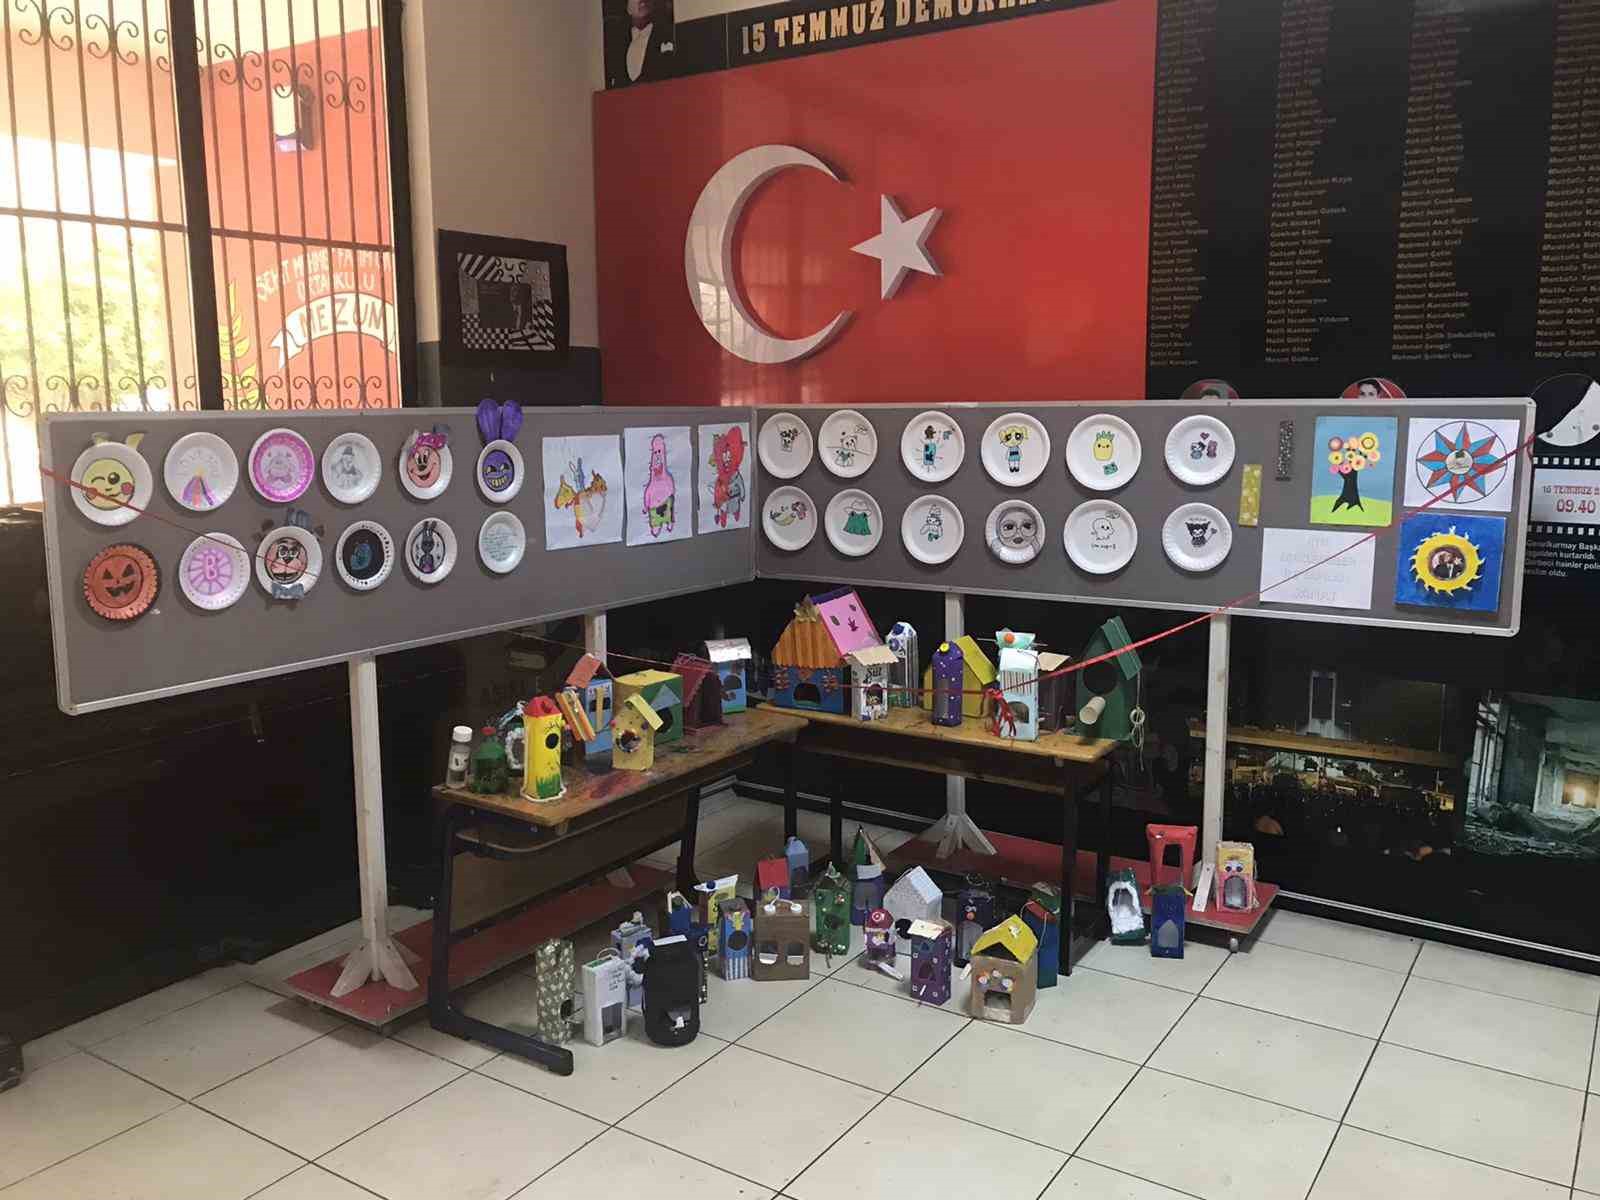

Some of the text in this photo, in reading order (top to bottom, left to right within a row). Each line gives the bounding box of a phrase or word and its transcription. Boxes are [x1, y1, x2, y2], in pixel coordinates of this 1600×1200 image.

[742, 23, 766, 54] 15
[774, 4, 885, 47] TEMMUZ
[1557, 499, 1596, 514] 09.40
